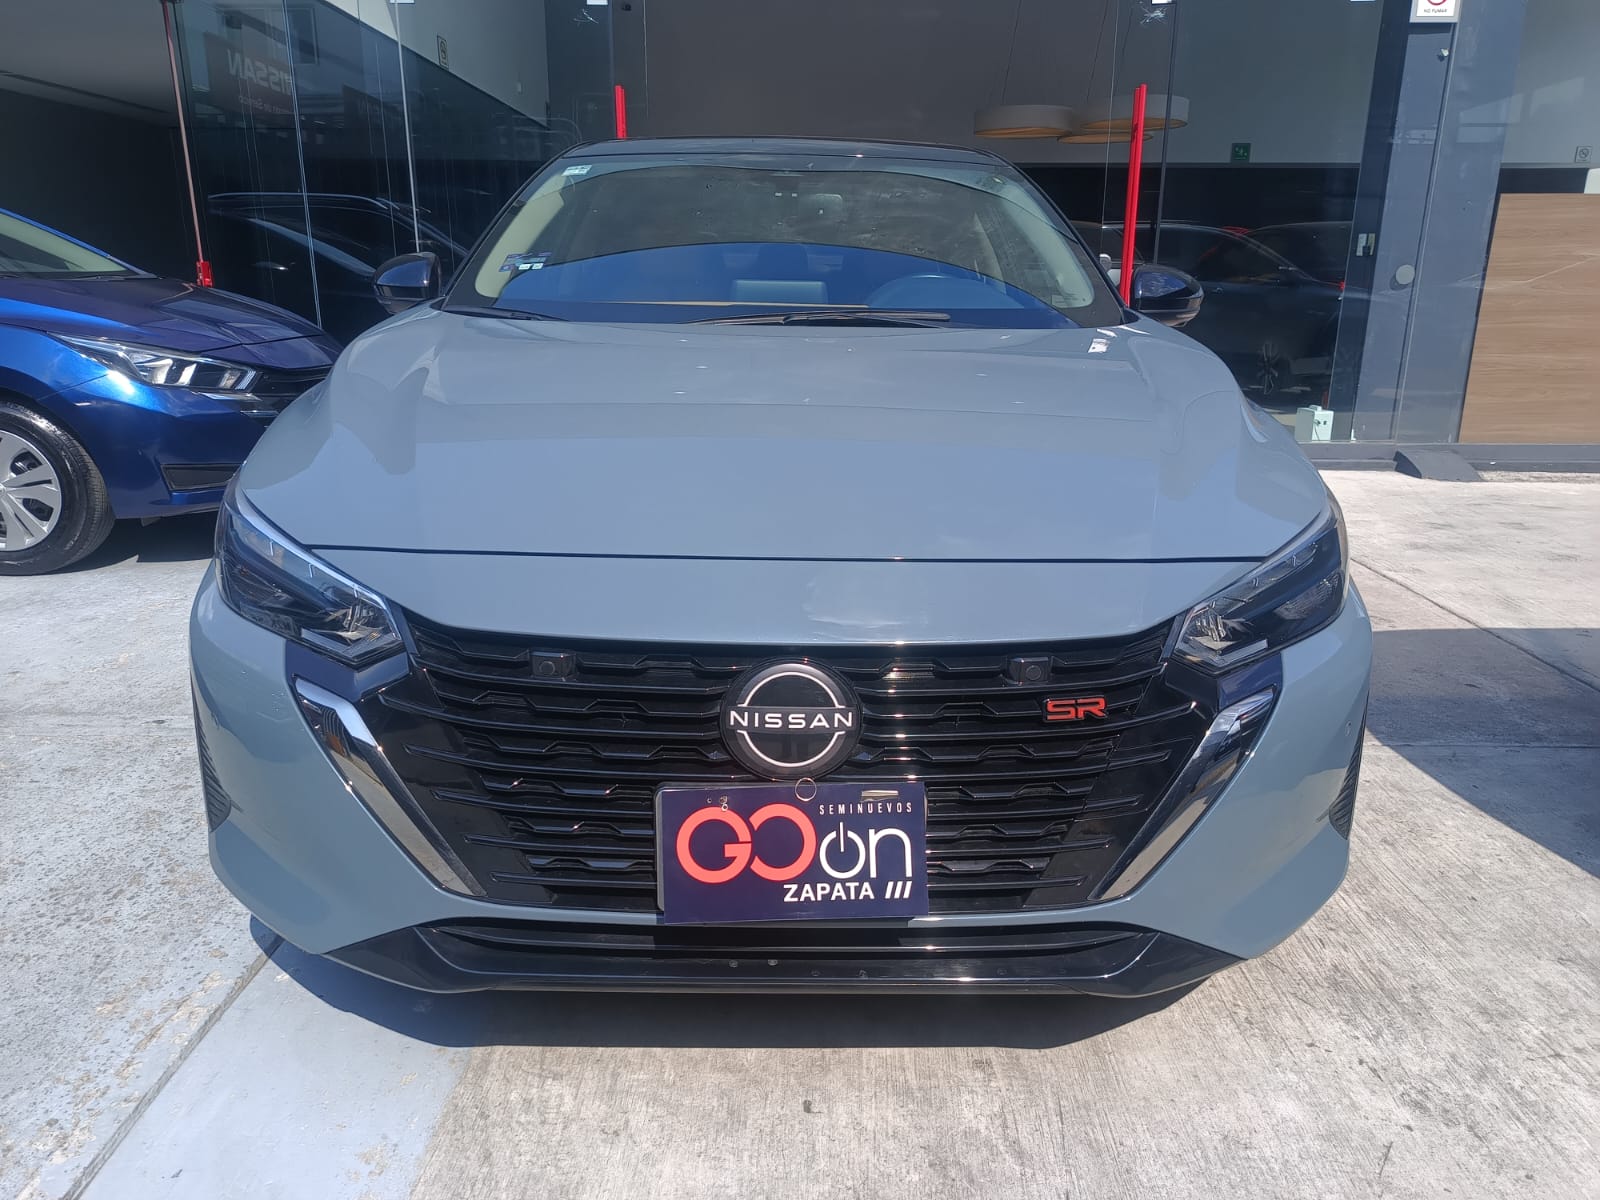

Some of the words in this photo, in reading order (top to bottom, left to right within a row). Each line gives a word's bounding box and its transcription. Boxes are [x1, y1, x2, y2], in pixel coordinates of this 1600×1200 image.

[1046, 697, 1106, 720] SR
[729, 710, 853, 729] NISSAN
[819, 802, 913, 816] SEMINUEVOS
[783, 882, 875, 903] ZAPATA
